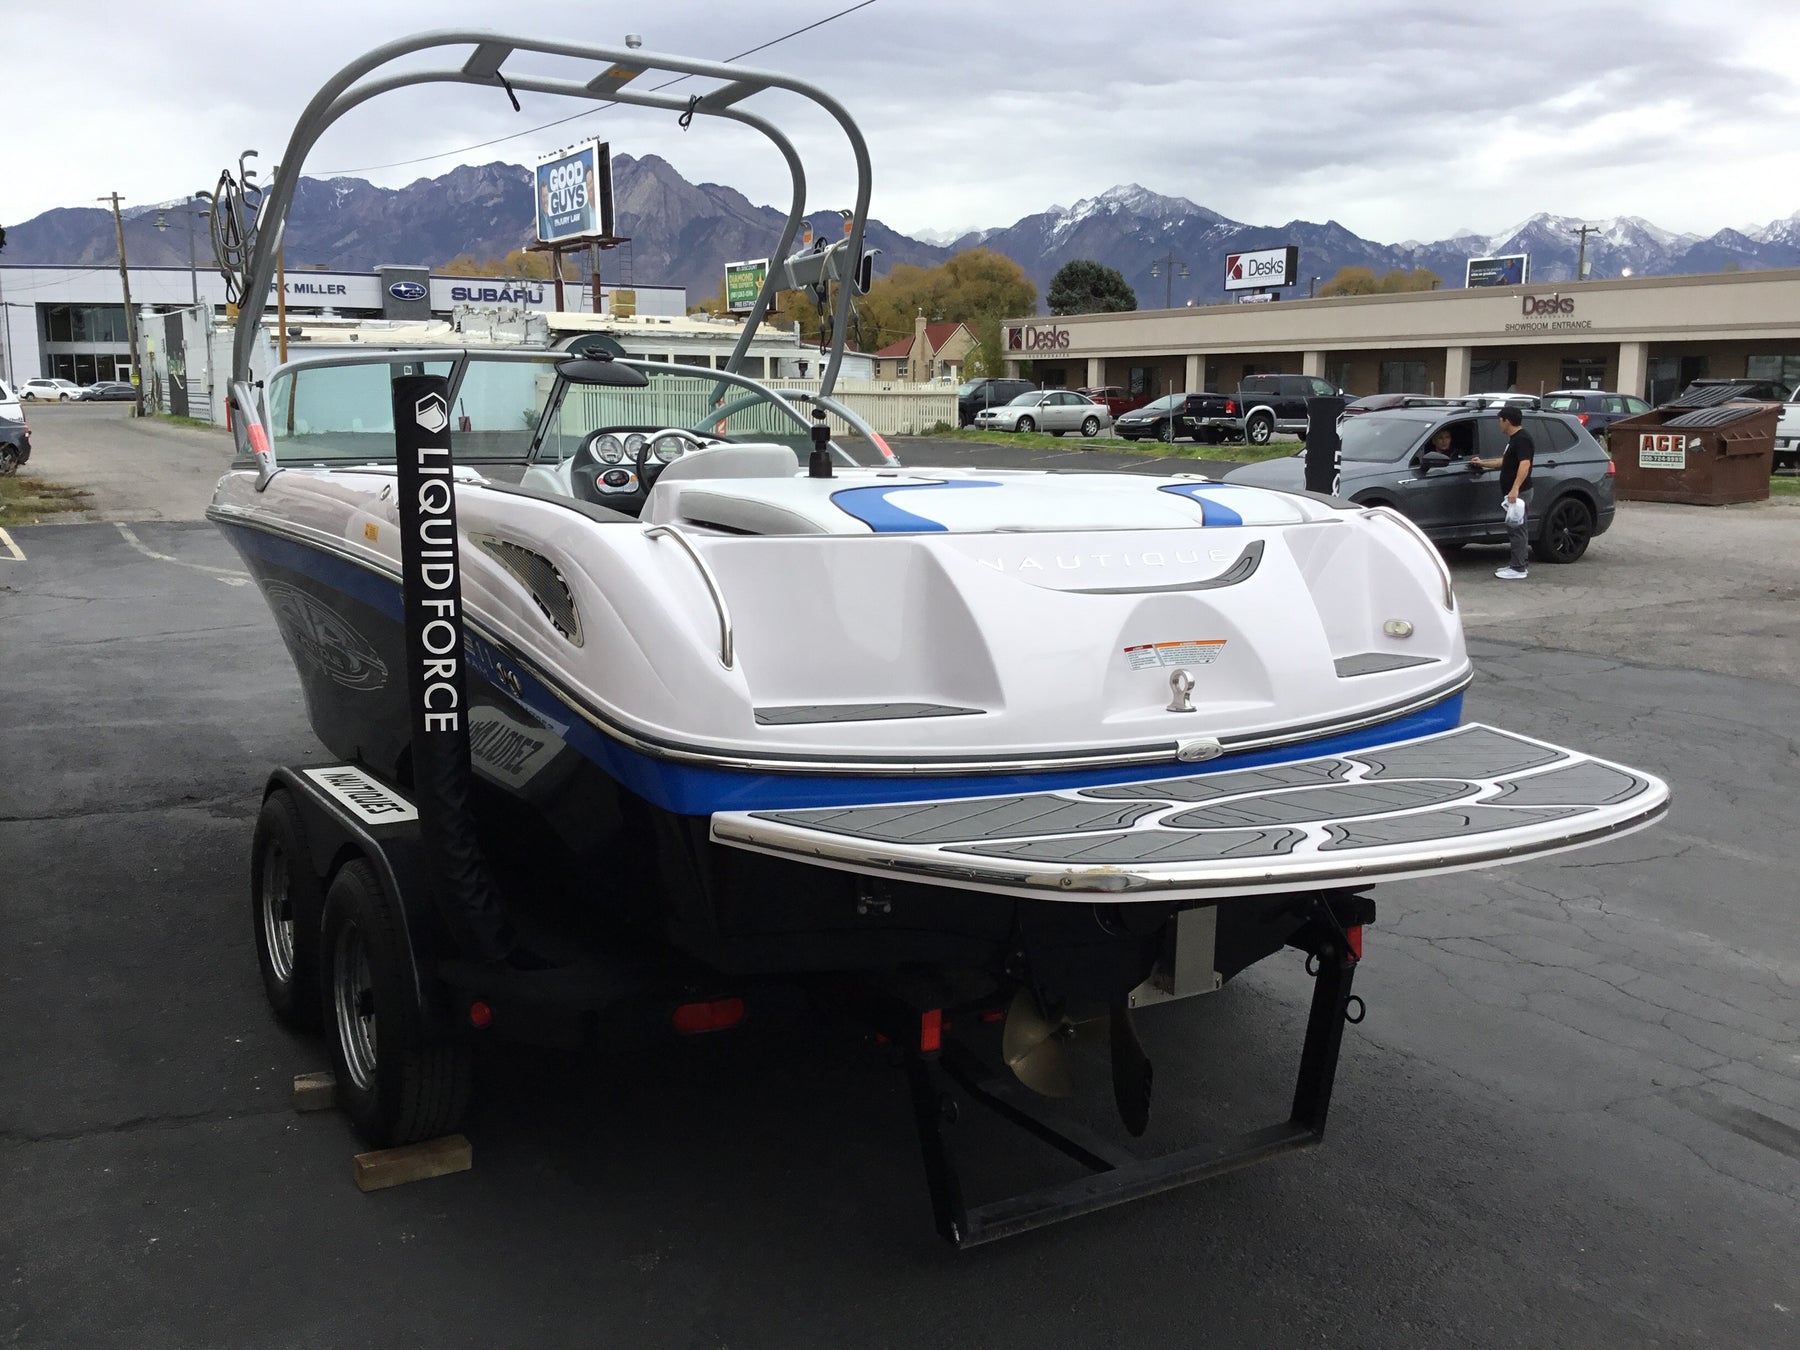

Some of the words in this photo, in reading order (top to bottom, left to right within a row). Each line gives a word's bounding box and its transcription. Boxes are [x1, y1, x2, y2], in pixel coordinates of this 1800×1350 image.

[550, 160, 583, 191] GOOD
[551, 184, 585, 214] GUYS
[554, 217, 570, 227] INJURY
[570, 213, 580, 222] LAW
[1248, 257, 1284, 277] Desks
[729, 273, 753, 283] DIAMOND
[294, 283, 347, 295] MILLER
[451, 287, 543, 304] SUBARU
[1522, 293, 1574, 316] Desks
[1505, 323, 1548, 331] SHOWROOM
[1552, 320, 1592, 329] ENTRANCE
[1025, 325, 1070, 350] Desks
[1642, 435, 1683, 451] ACE
[976, 549, 1231, 572] NAUTIQUE
[320, 773, 406, 814] NAUTIQUES
